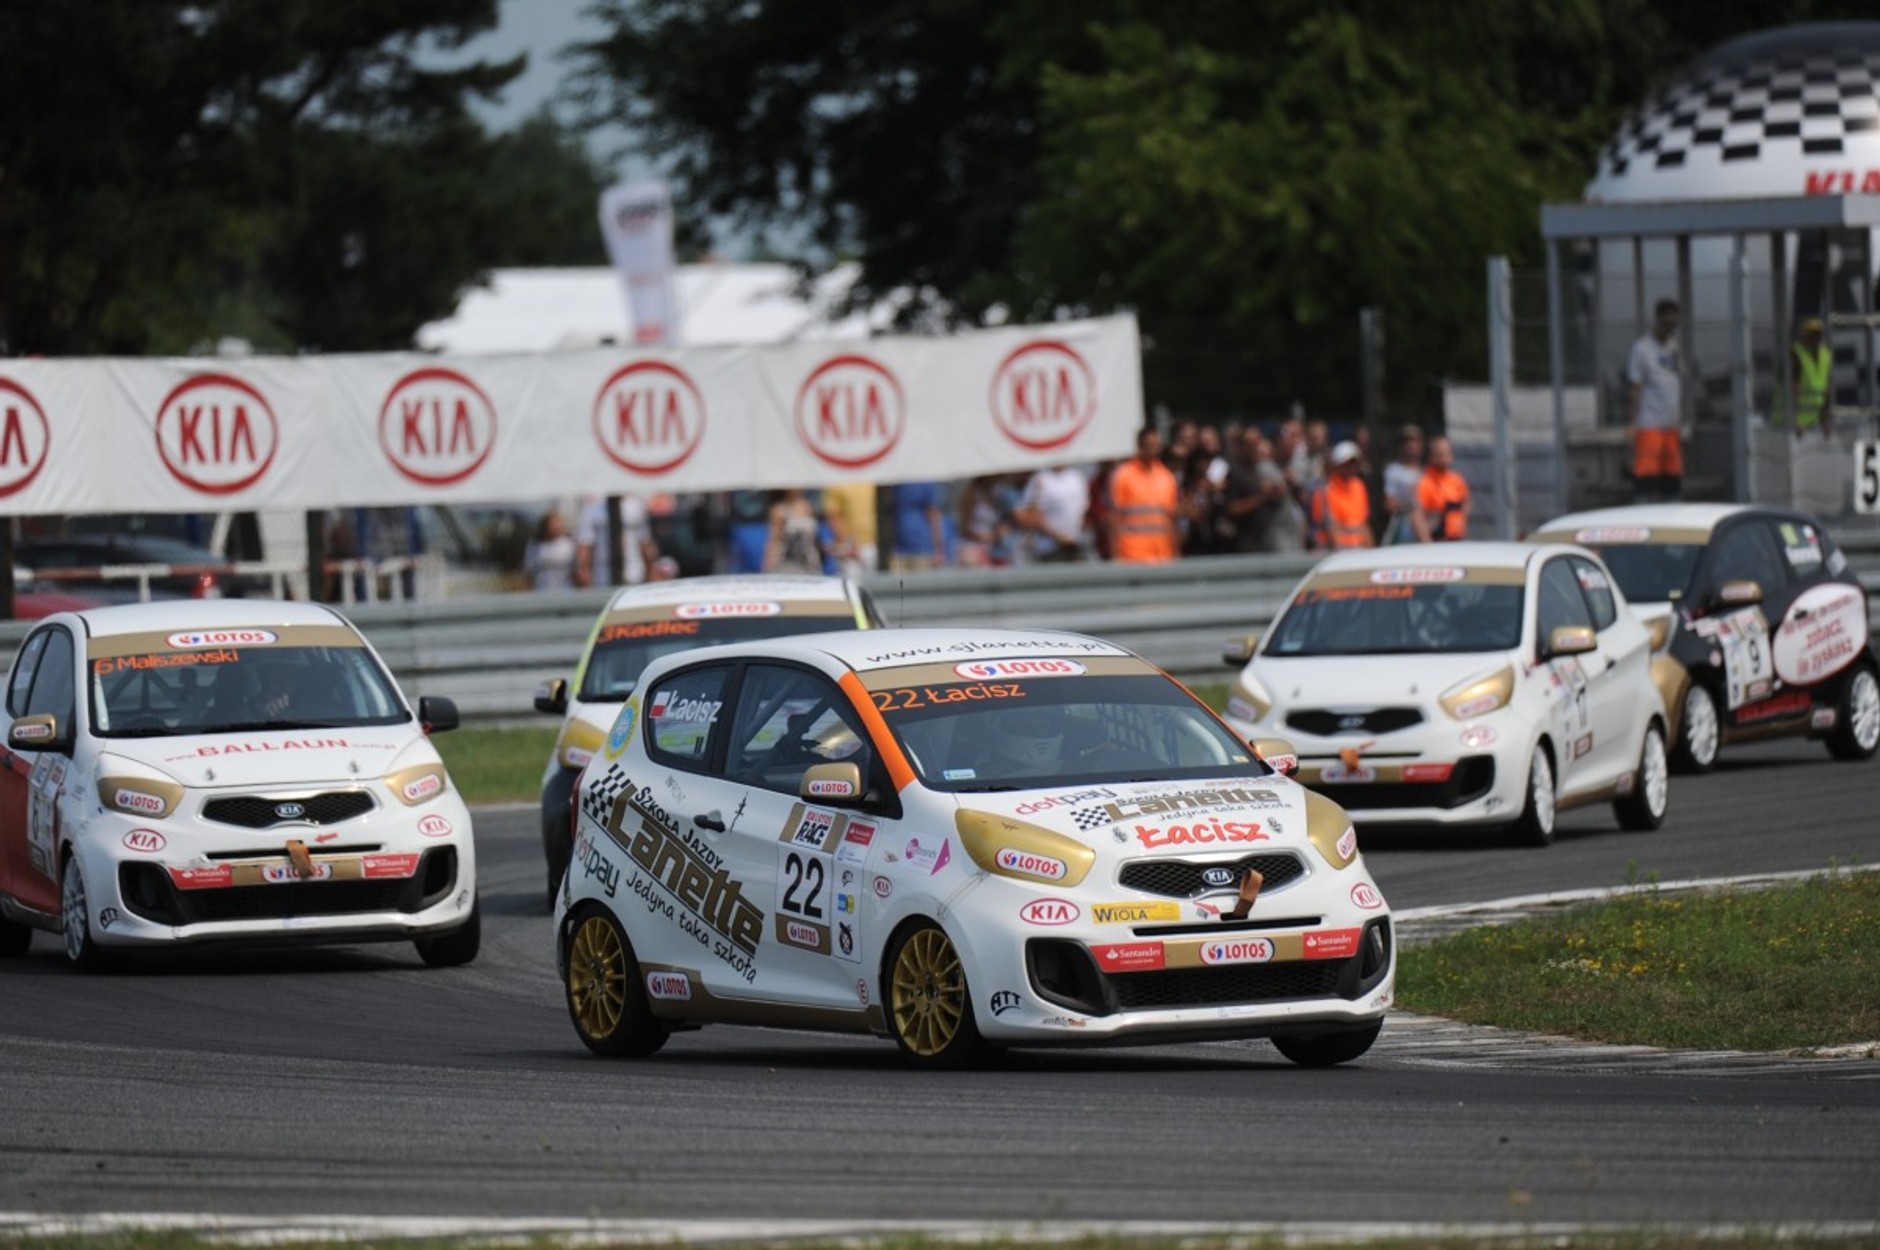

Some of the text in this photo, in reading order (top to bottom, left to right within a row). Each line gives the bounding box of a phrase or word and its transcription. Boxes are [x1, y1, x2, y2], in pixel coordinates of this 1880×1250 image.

[1008, 352, 1077, 424] KIA
[615, 388, 687, 446] KIA
[817, 382, 887, 440] KIA
[179, 405, 256, 464] KIA
[402, 399, 474, 456] KIA
[711, 602, 770, 614] LOTOS
[204, 632, 265, 643] LOTOS
[615, 621, 699, 638] Kadlec
[94, 647, 239, 675] 6 Maliszewski
[1001, 659, 1073, 675] LOTOS
[665, 689, 723, 722] Łacisz
[870, 682, 1026, 712] 22 Łacisz
[821, 783, 848, 793] LOTOS
[130, 795, 160, 811] LOTOS
[280, 805, 299, 815] KIA
[1015, 788, 1117, 817] dotpay
[1103, 788, 1280, 821] Lanette
[424, 820, 449, 833] KIA
[1135, 817, 1270, 849] Łacisz
[130, 832, 158, 849] KIA
[606, 783, 765, 948] Lanette
[1018, 855, 1059, 876] LOTOS
[782, 852, 824, 919] 22
[1207, 870, 1232, 883] KIA
[1356, 889, 1376, 905] KIA
[1031, 905, 1070, 920] KIA
[679, 911, 709, 948] taka
[1317, 934, 1352, 945] Santander
[1119, 947, 1161, 959] Santander
[1225, 943, 1266, 959] LOTOS
[662, 977, 688, 996] LOTOS
